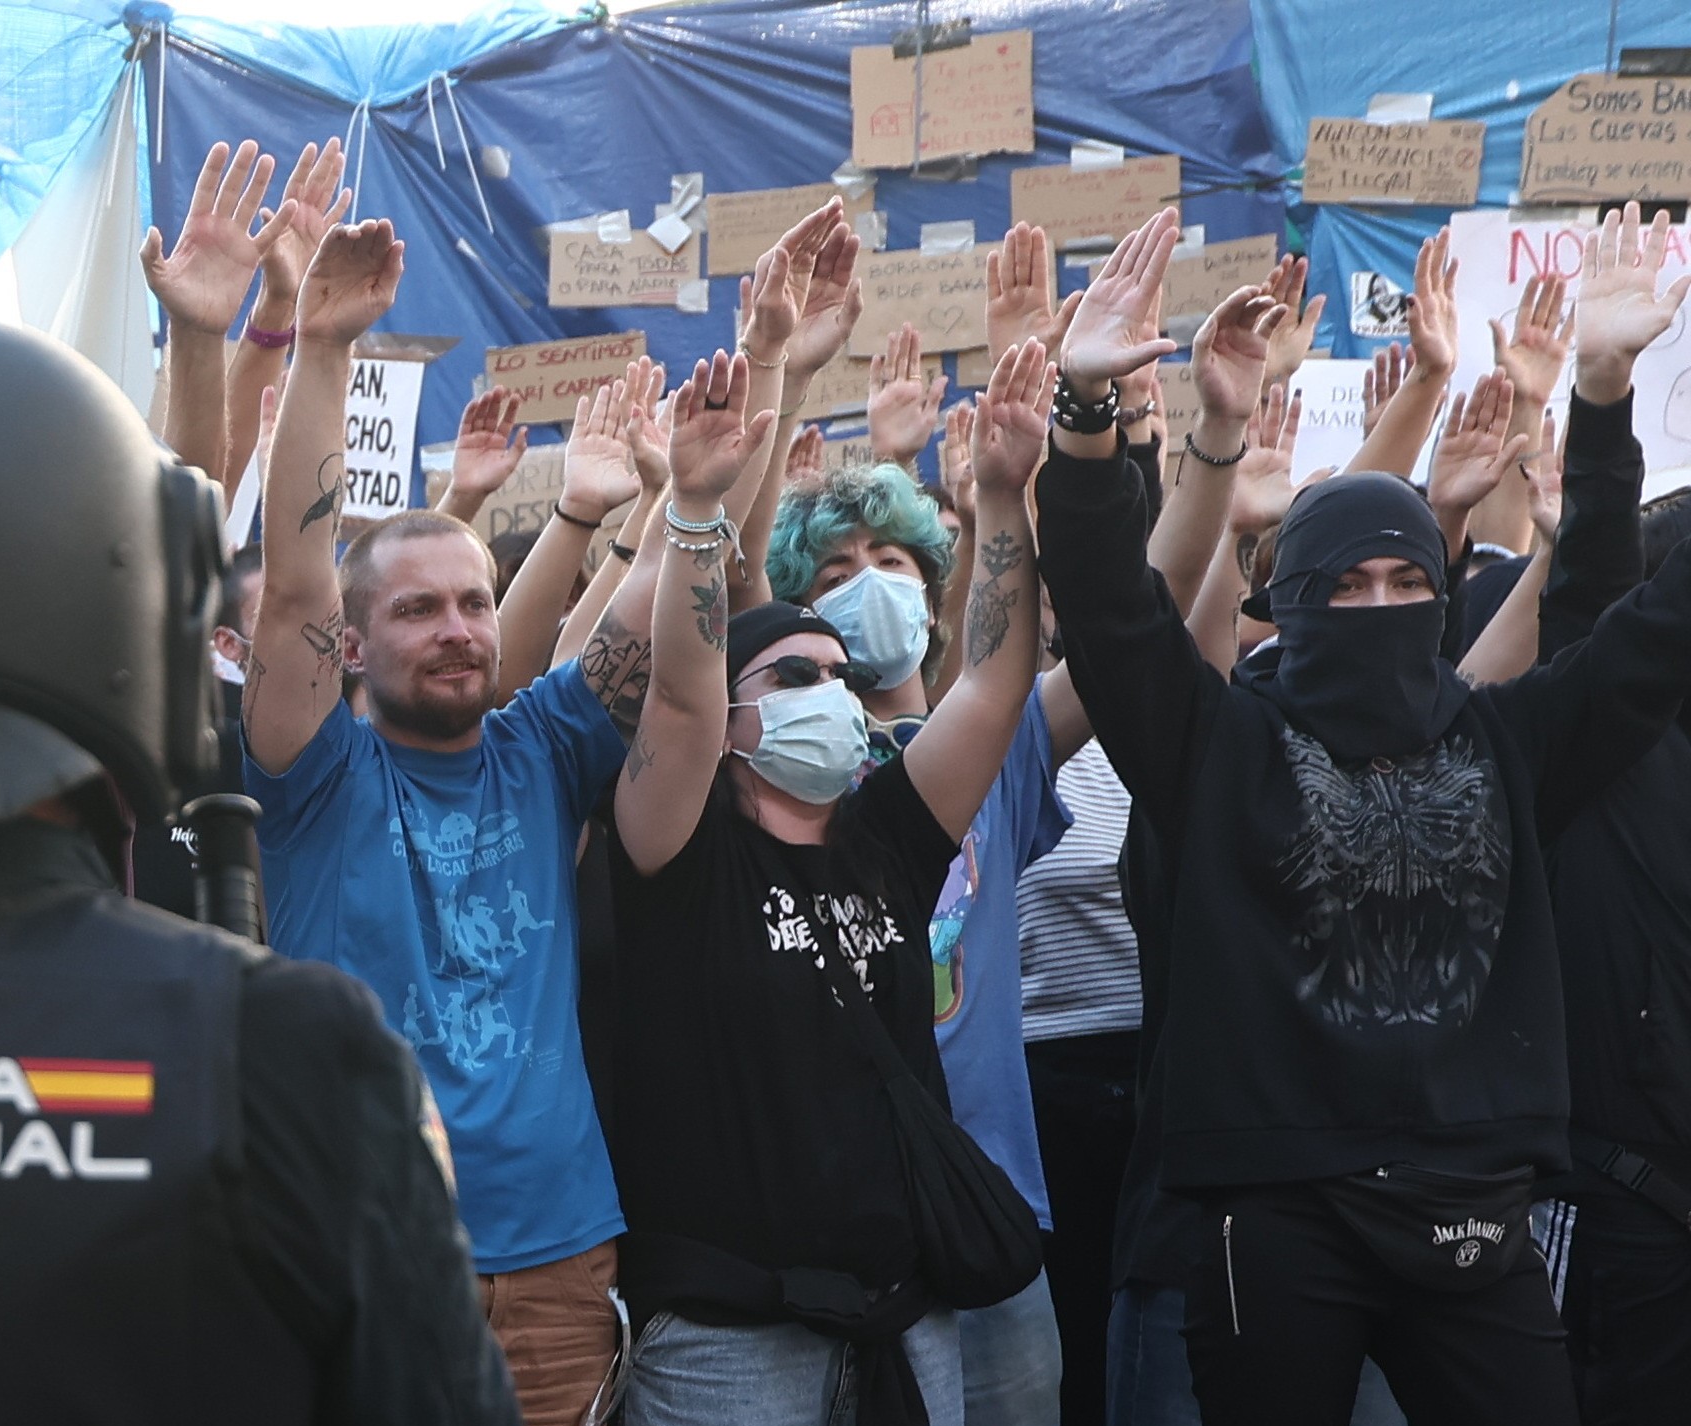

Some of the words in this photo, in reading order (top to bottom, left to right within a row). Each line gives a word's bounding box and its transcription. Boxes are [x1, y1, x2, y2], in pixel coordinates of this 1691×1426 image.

[1590, 117, 1676, 143] Cuevas
[565, 241, 624, 260] CASA
[1508, 229, 1584, 284] NO
[940, 278, 987, 294] BAKA
[495, 349, 527, 372] LO
[536, 338, 633, 367] SENTIMOS
[553, 373, 621, 397] CARME
[427, 854, 469, 877] LOCAL
[1432, 1223, 1466, 1245] JACK
